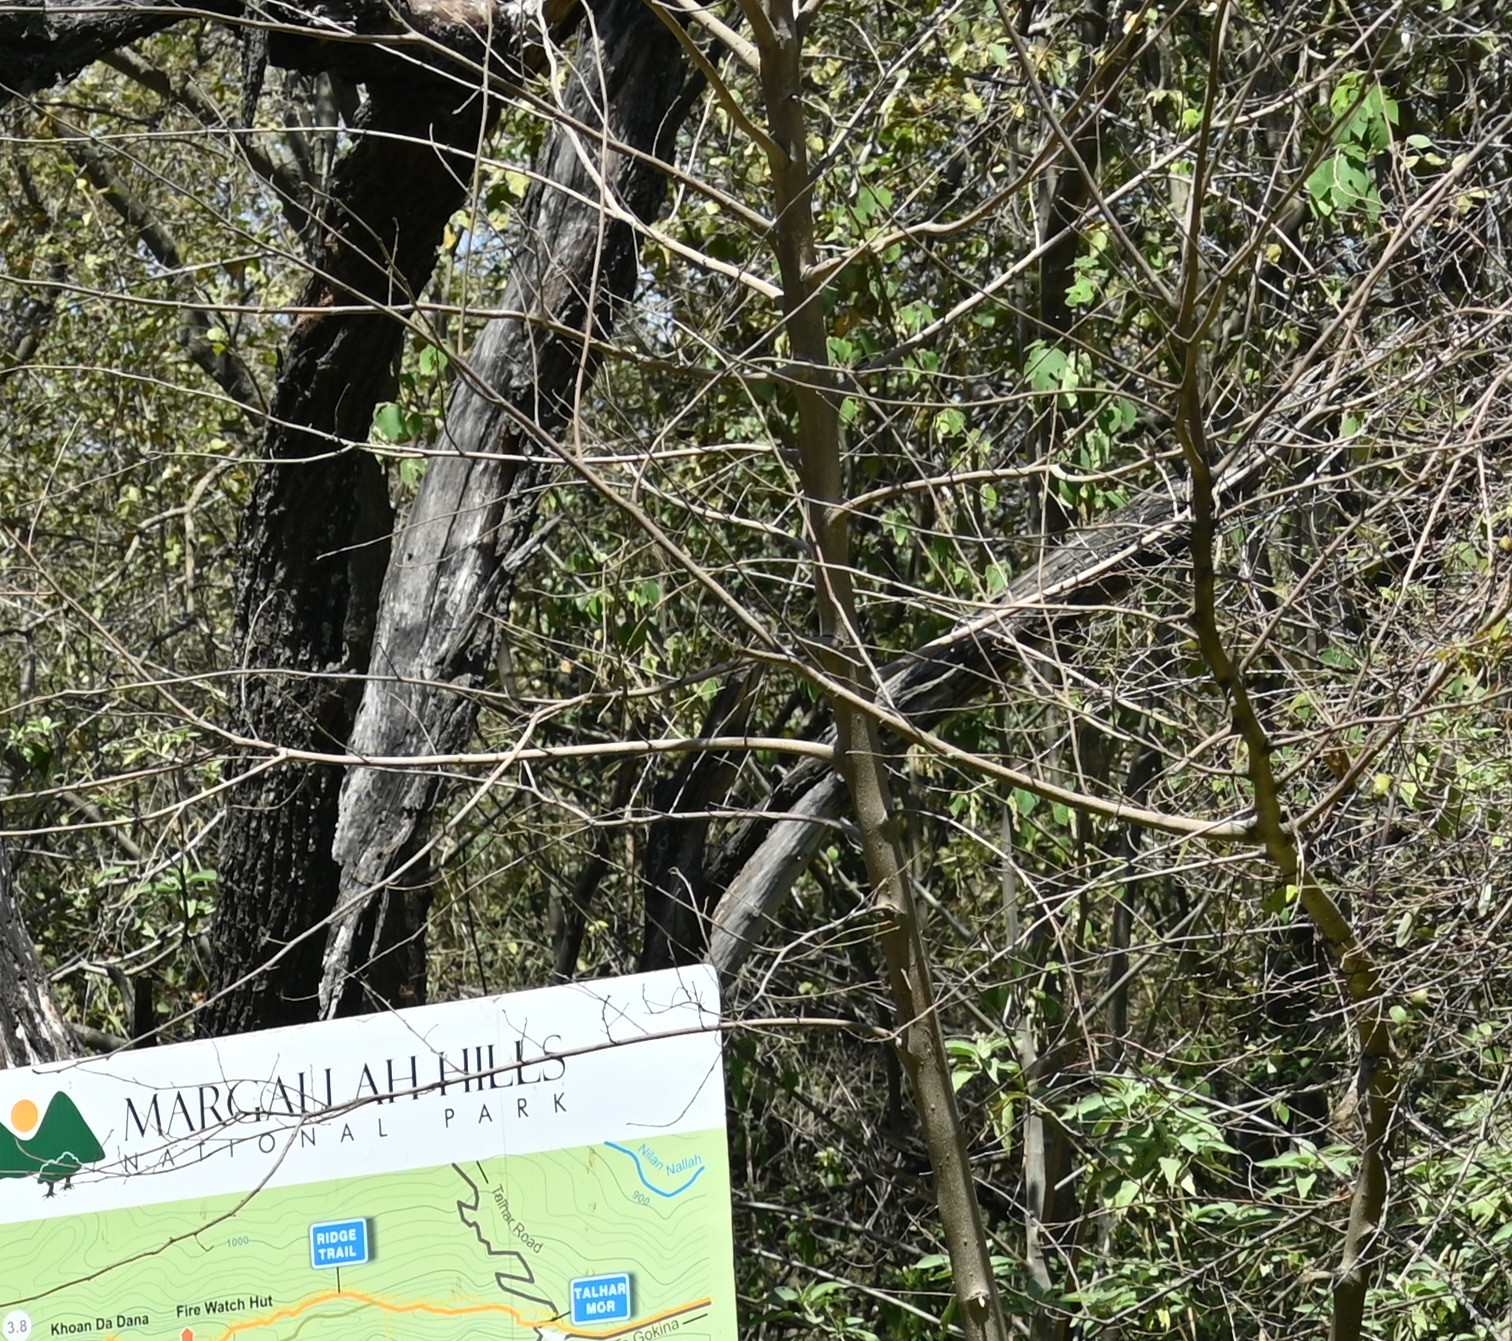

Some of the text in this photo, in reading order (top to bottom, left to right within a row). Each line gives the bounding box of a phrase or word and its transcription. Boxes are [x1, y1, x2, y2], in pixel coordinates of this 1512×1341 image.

[124, 1034, 566, 1141] MARGALLAH HILLS
[124, 1093, 567, 1173] NATIONAL PARK
[638, 1144, 702, 1176] Nilan Nallah
[492, 1184, 543, 1254] Talhar Road
[317, 1229, 356, 1245] RIDGE
[319, 1246, 356, 1260] TRAIL
[574, 1283, 626, 1299] TALHAR
[177, 1296, 272, 1318] Fire Watch Hut
[586, 1301, 615, 1314] MOR
[7, 1320, 27, 1334] 3.8
[51, 1314, 149, 1336] Khoan Da Dana
